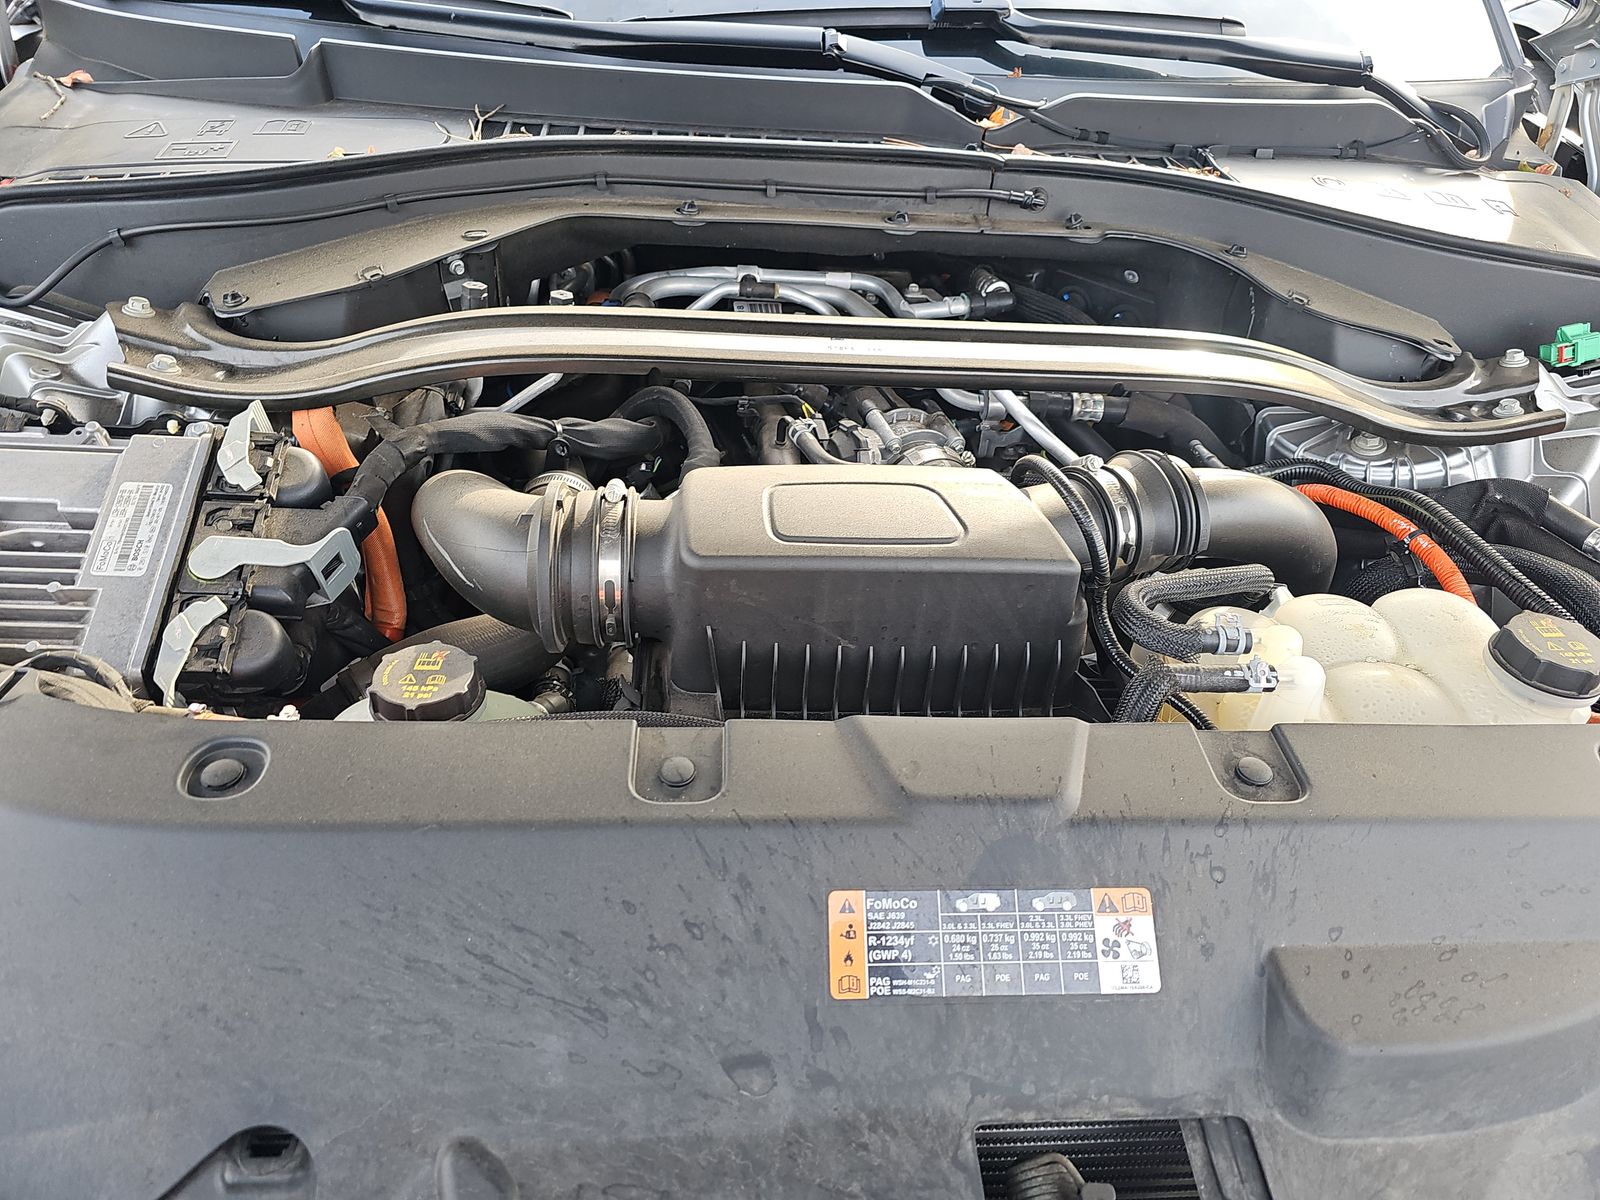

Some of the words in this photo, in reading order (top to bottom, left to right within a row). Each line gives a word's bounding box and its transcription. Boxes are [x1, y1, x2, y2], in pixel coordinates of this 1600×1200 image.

[131, 539, 145, 561] BOSCH
[96, 541, 113, 570] FoMoCo
[866, 897, 918, 910] FoMoCo
[868, 912, 884, 920] SAE
[886, 912, 905, 920] J639
[869, 935, 915, 948] R-1234yf
[944, 934, 965, 943] 0.680
[966, 934, 977, 944] kg
[983, 933, 1003, 942] 0.737
[1004, 934, 1015, 944] kg
[1024, 933, 1045, 942] 0.992
[1045, 932, 1056, 943] kg
[1062, 933, 1083, 942] 0.992
[1084, 933, 1094, 943] kg
[952, 944, 961, 952] 24
[869, 950, 900, 962] (GWP
[902, 950, 912, 961] 4)
[988, 952, 1001, 960] 1.63
[1002, 952, 1013, 960] lbs
[1029, 951, 1042, 959] 2.19
[1044, 951, 1054, 959] lbs
[1066, 951, 1081, 959] 2.19
[1082, 950, 1093, 958] lbs
[870, 976, 891, 986] PAG
[955, 974, 972, 983] PAG
[995, 974, 1011, 982] POE
[1034, 973, 1051, 981] PAG
[870, 986, 891, 995] POE
